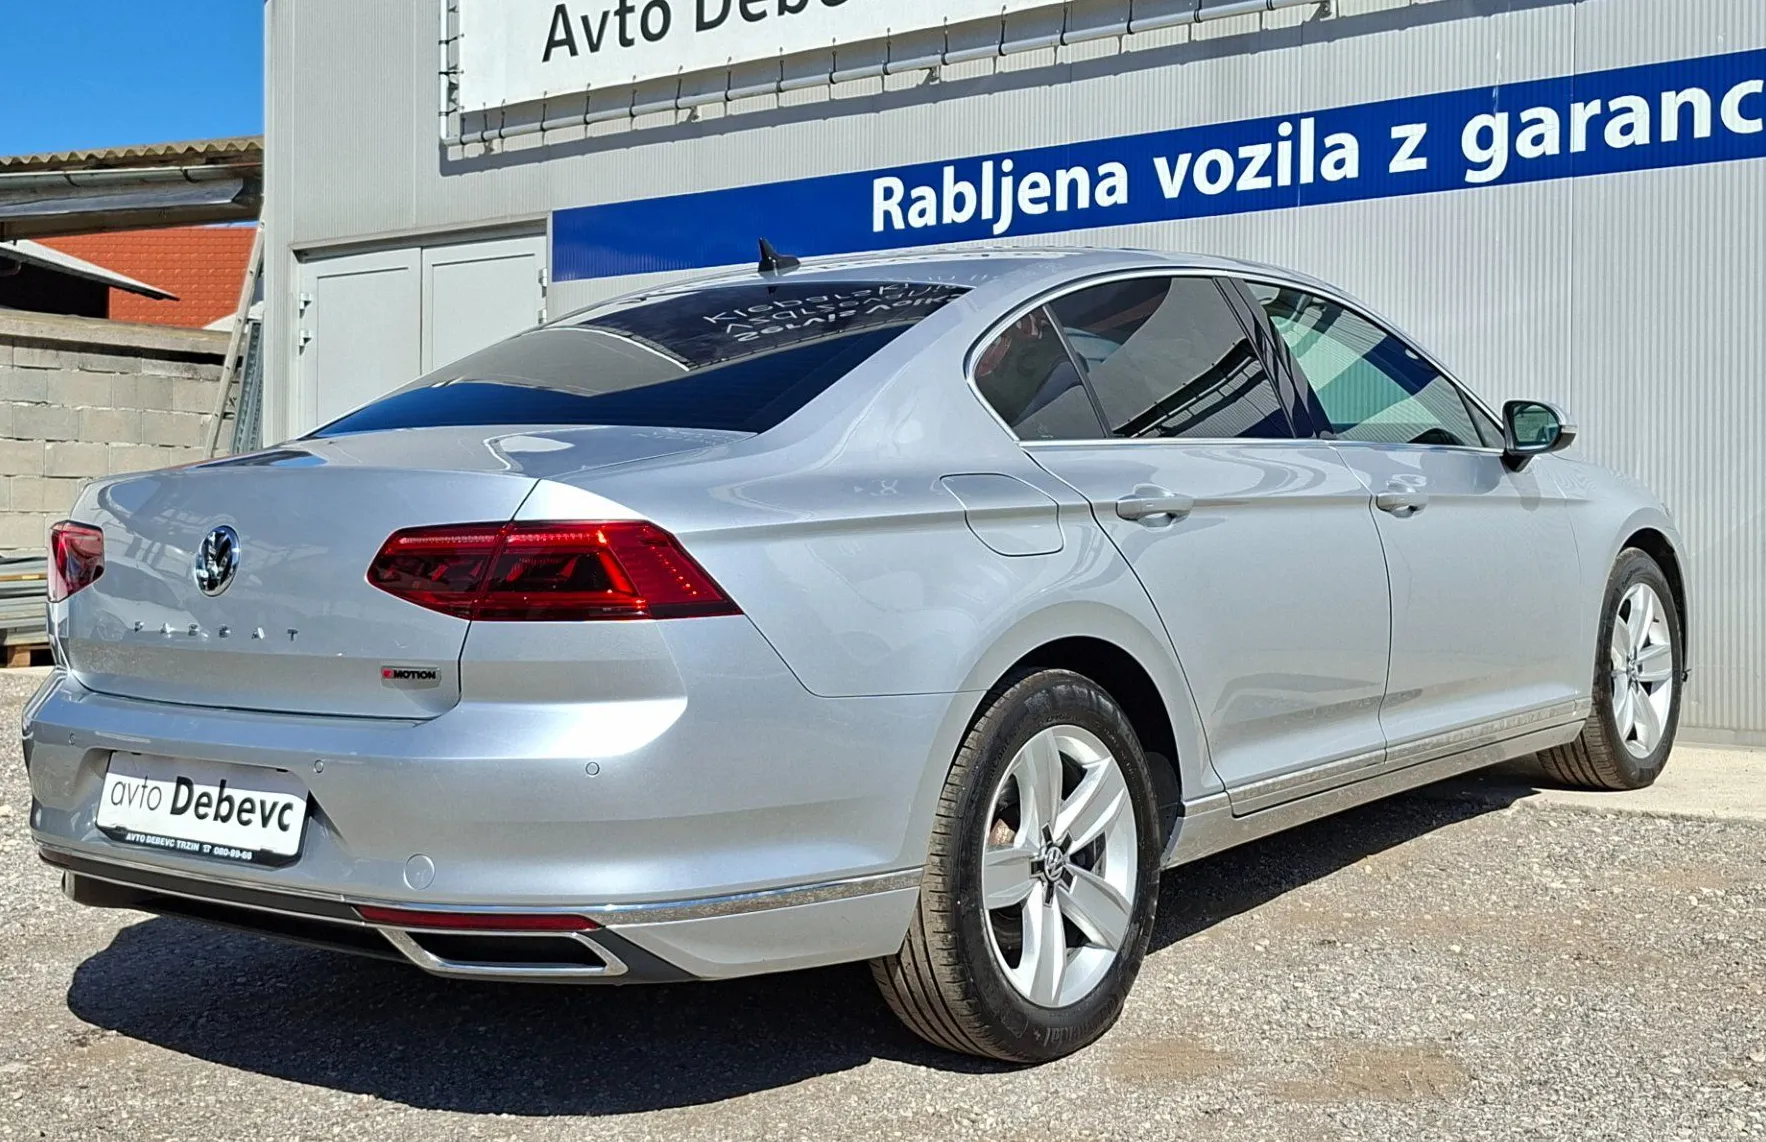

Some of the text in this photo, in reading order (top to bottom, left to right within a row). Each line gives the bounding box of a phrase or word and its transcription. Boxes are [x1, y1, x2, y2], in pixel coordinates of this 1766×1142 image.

[542, 0, 672, 63] Avto
[872, 78, 1765, 236] Rabljena vozila z garanc
[110, 775, 294, 833] avto Debevc
[125, 832, 145, 844] AVTO
[145, 835, 176, 848] DEBEVC
[176, 839, 200, 852] TRZIN
